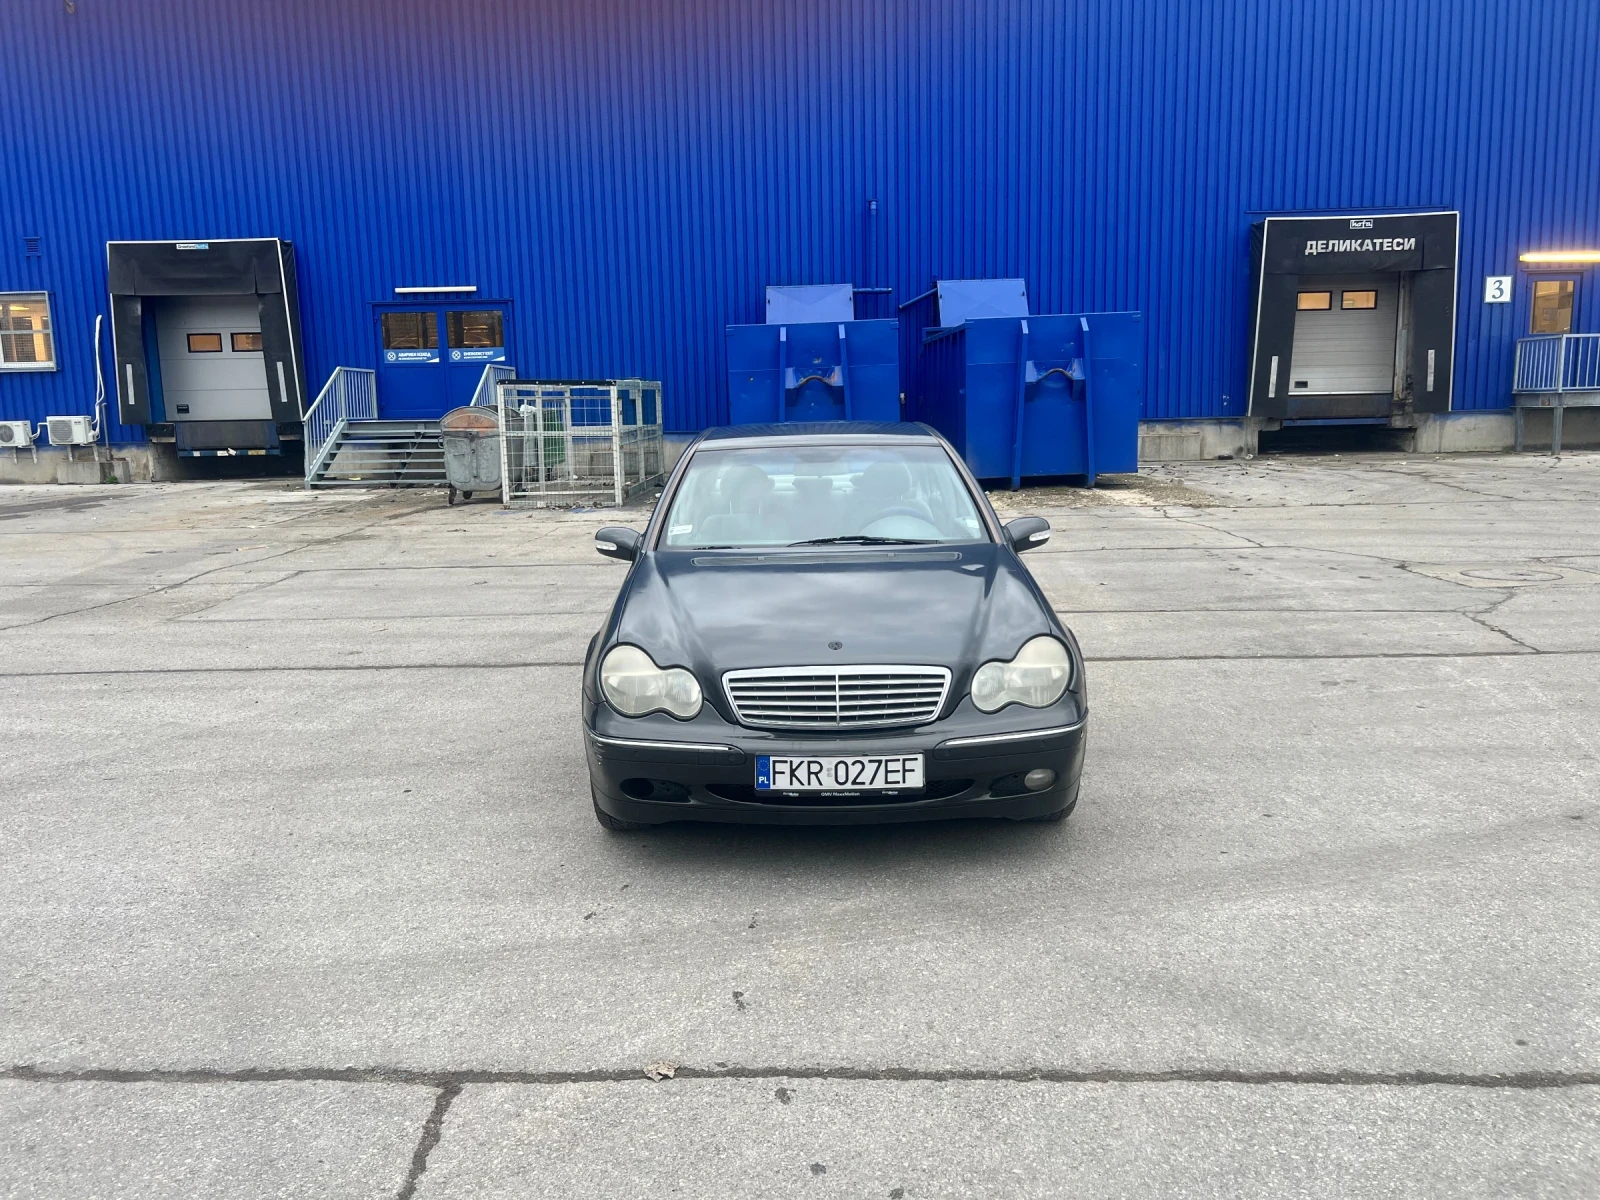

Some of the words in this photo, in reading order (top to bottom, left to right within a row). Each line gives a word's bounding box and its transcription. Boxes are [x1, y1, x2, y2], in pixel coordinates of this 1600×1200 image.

[1304, 238, 1416, 255] ДЕЛИКАТЕСИ
[1491, 279, 1504, 299] 3
[758, 776, 769, 784] PL
[772, 760, 824, 786] FKR
[834, 757, 918, 786] 027EF
